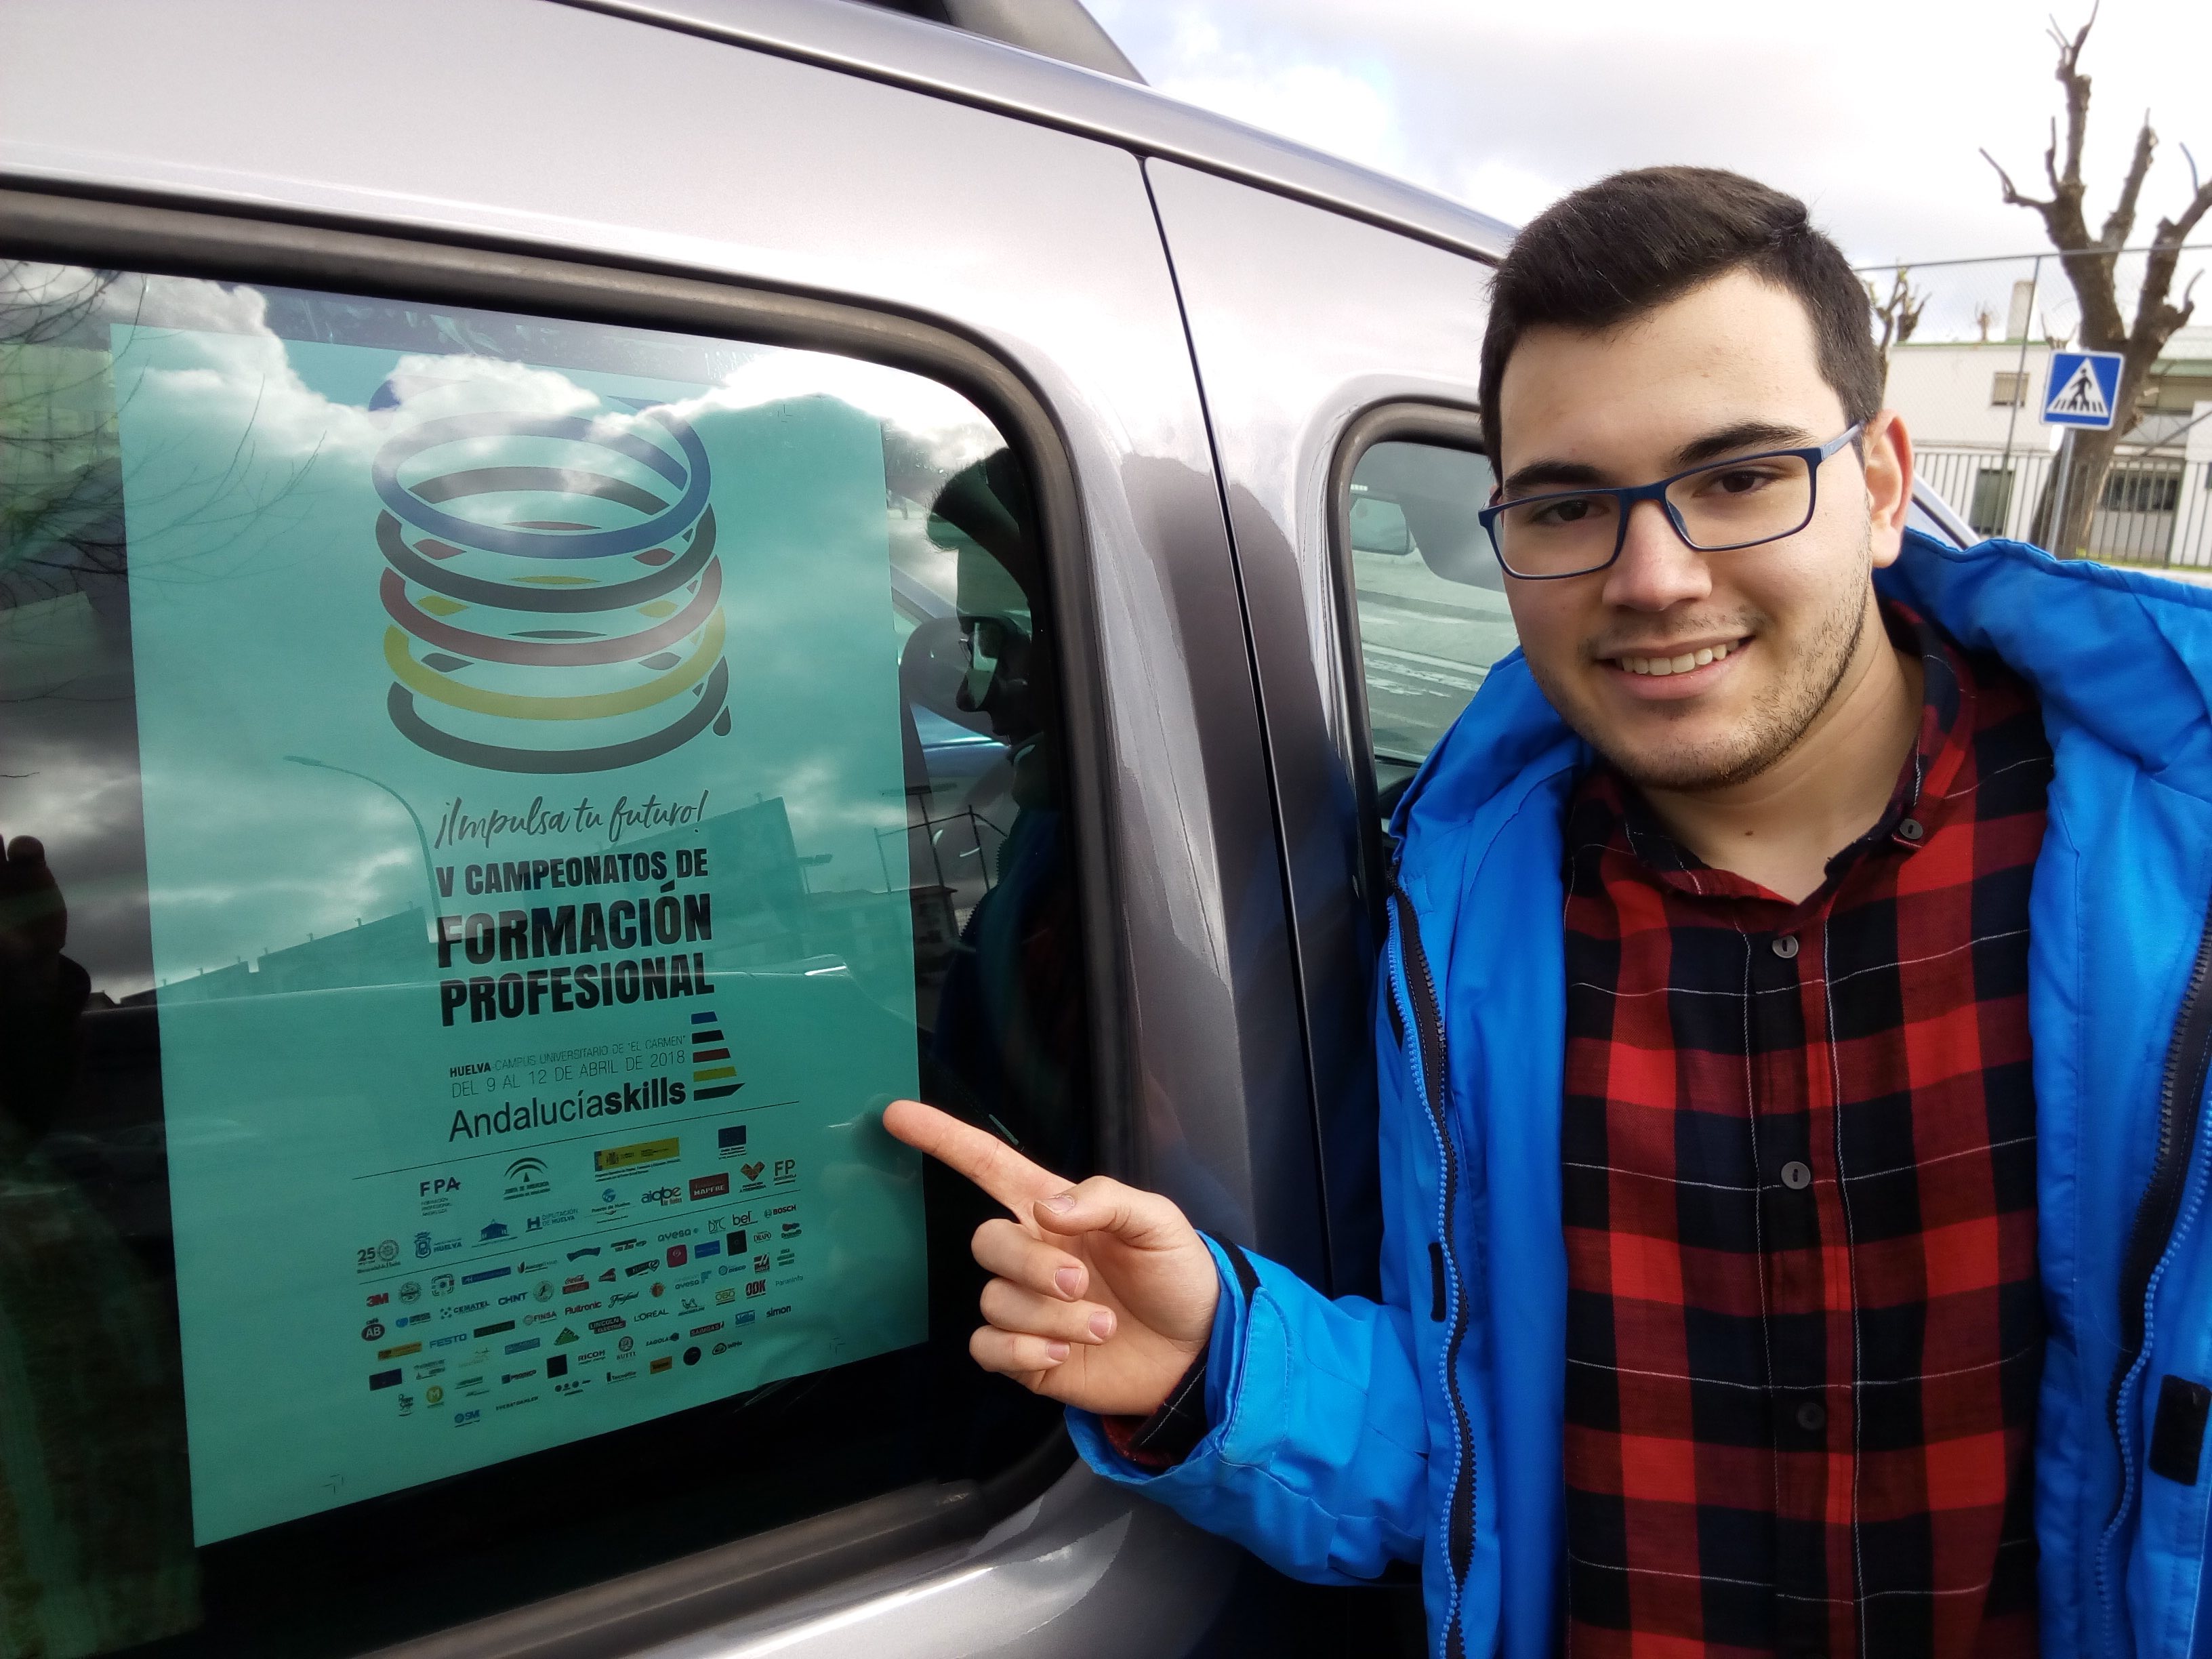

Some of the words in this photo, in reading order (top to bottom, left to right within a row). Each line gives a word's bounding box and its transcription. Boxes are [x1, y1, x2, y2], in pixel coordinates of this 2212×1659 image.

[575, 797, 603, 834] tu
[608, 790, 709, 842] futuro!
[436, 865, 454, 897] V
[465, 853, 668, 896] CAMPEONATOS
[676, 848, 708, 878] DE
[436, 880, 712, 968] FORMACIÓN
[440, 953, 714, 1027] PROFESIONAL
[450, 1063, 491, 1078] HUELVA
[613, 1044, 623, 1054] DE
[452, 1080, 478, 1098] DEL
[487, 1078, 495, 1092] 9
[502, 1074, 520, 1089] AL
[529, 1069, 546, 1084] 12
[555, 1065, 573, 1082] DE
[579, 1059, 618, 1078] ABRIL
[626, 1055, 643, 1071] DE
[651, 1050, 685, 1068] 2018
[449, 1078, 687, 1142] Andalucíaskills
[775, 1159, 795, 1176] FP
[694, 1184, 724, 1196] MAPFRE
[773, 1204, 796, 1215] BOSCH
[357, 1247, 375, 1263] 25
[434, 1242, 462, 1252] HUELVA
[366, 1292, 389, 1307] 3M
[766, 1305, 792, 1317] simon
[366, 1327, 381, 1338] AB
[430, 1334, 466, 1348] FESTO
[578, 1350, 605, 1361] RICOH
